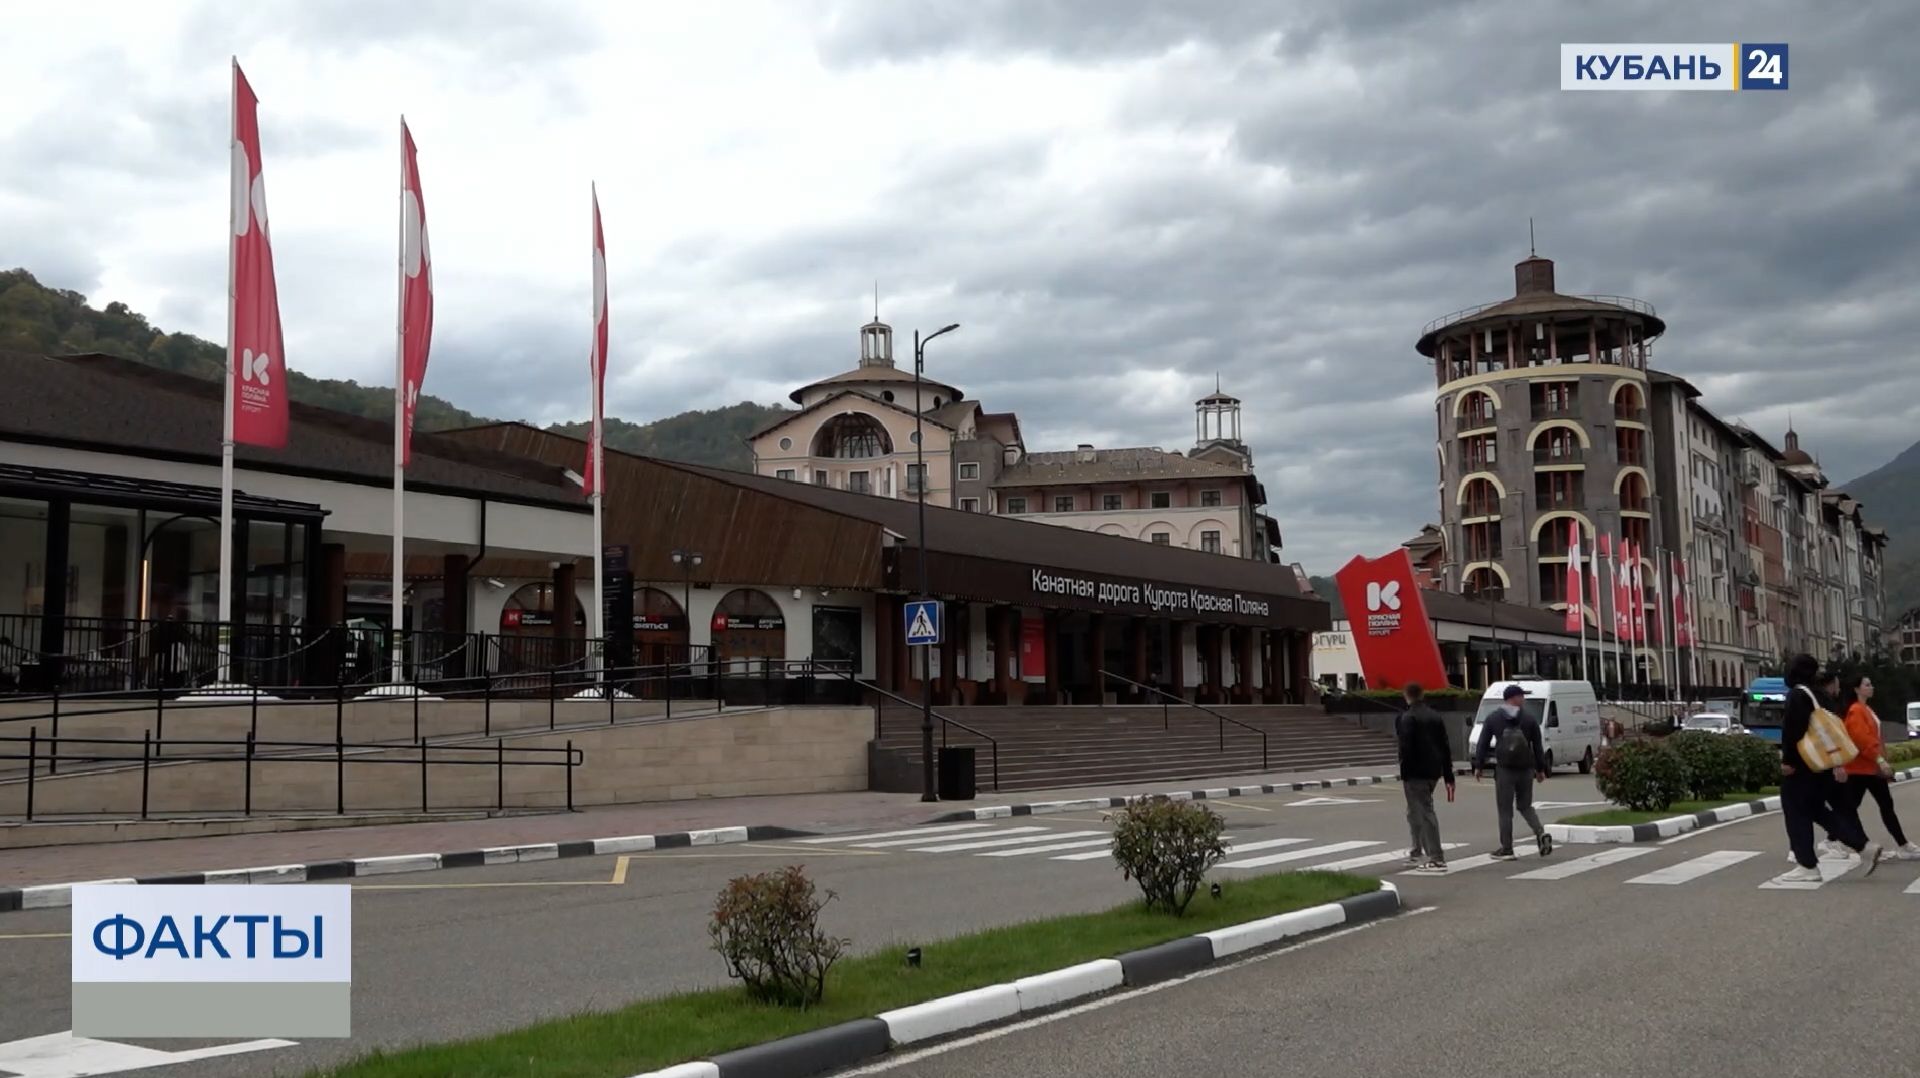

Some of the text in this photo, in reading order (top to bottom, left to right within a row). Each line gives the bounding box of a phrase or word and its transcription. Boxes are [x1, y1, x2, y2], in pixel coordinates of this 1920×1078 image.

[1032, 568, 1269, 617] Канатная дорога Курорта Красная Поляна
[1368, 613, 1401, 621] КРАСНАЯ
[633, 622, 669, 630] аняться
